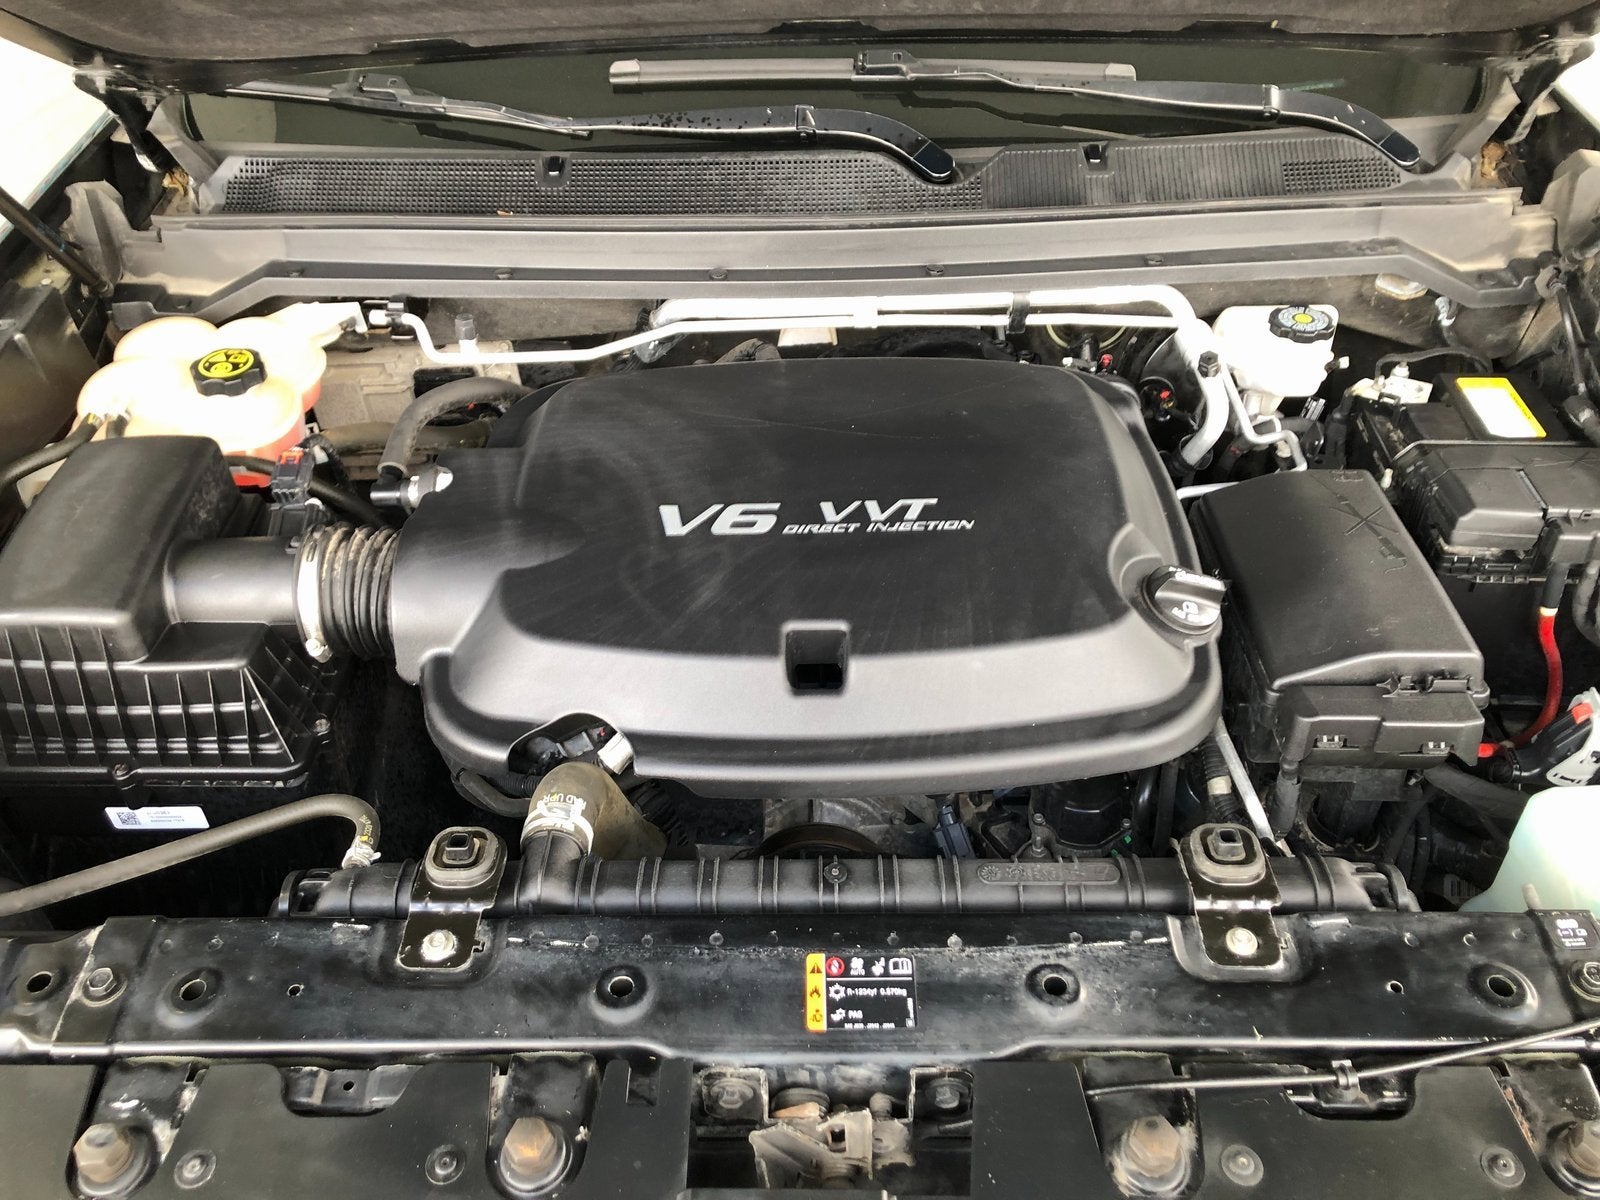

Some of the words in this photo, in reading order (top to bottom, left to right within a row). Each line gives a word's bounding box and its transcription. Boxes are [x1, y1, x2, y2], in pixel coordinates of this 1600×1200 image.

[658, 502, 781, 537] V6
[819, 498, 938, 522] VVT
[782, 522, 861, 535] DIRECT
[866, 519, 975, 533] INJECTION
